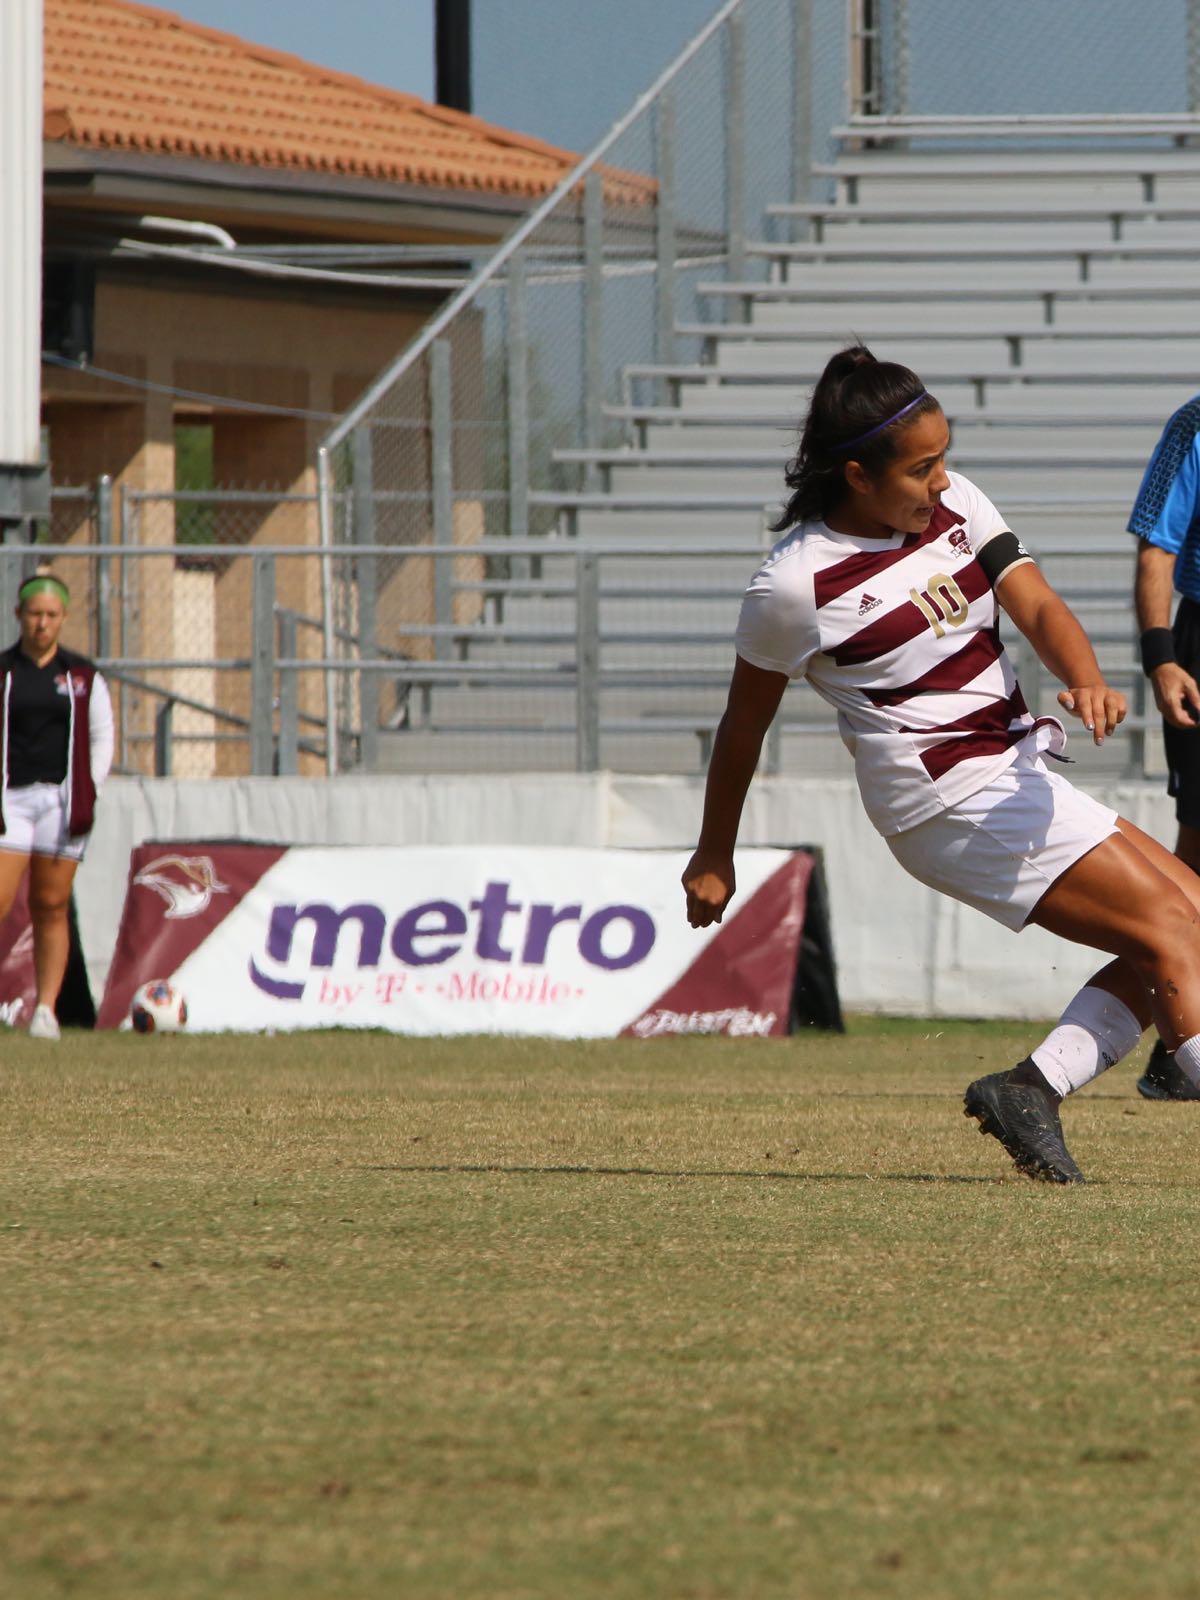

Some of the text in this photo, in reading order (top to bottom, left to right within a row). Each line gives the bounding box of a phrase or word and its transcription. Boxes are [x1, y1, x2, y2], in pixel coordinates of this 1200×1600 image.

[858, 598, 883, 617] adidas
[909, 573, 969, 639] 10
[264, 880, 657, 971] metro
[318, 977, 364, 1011] by
